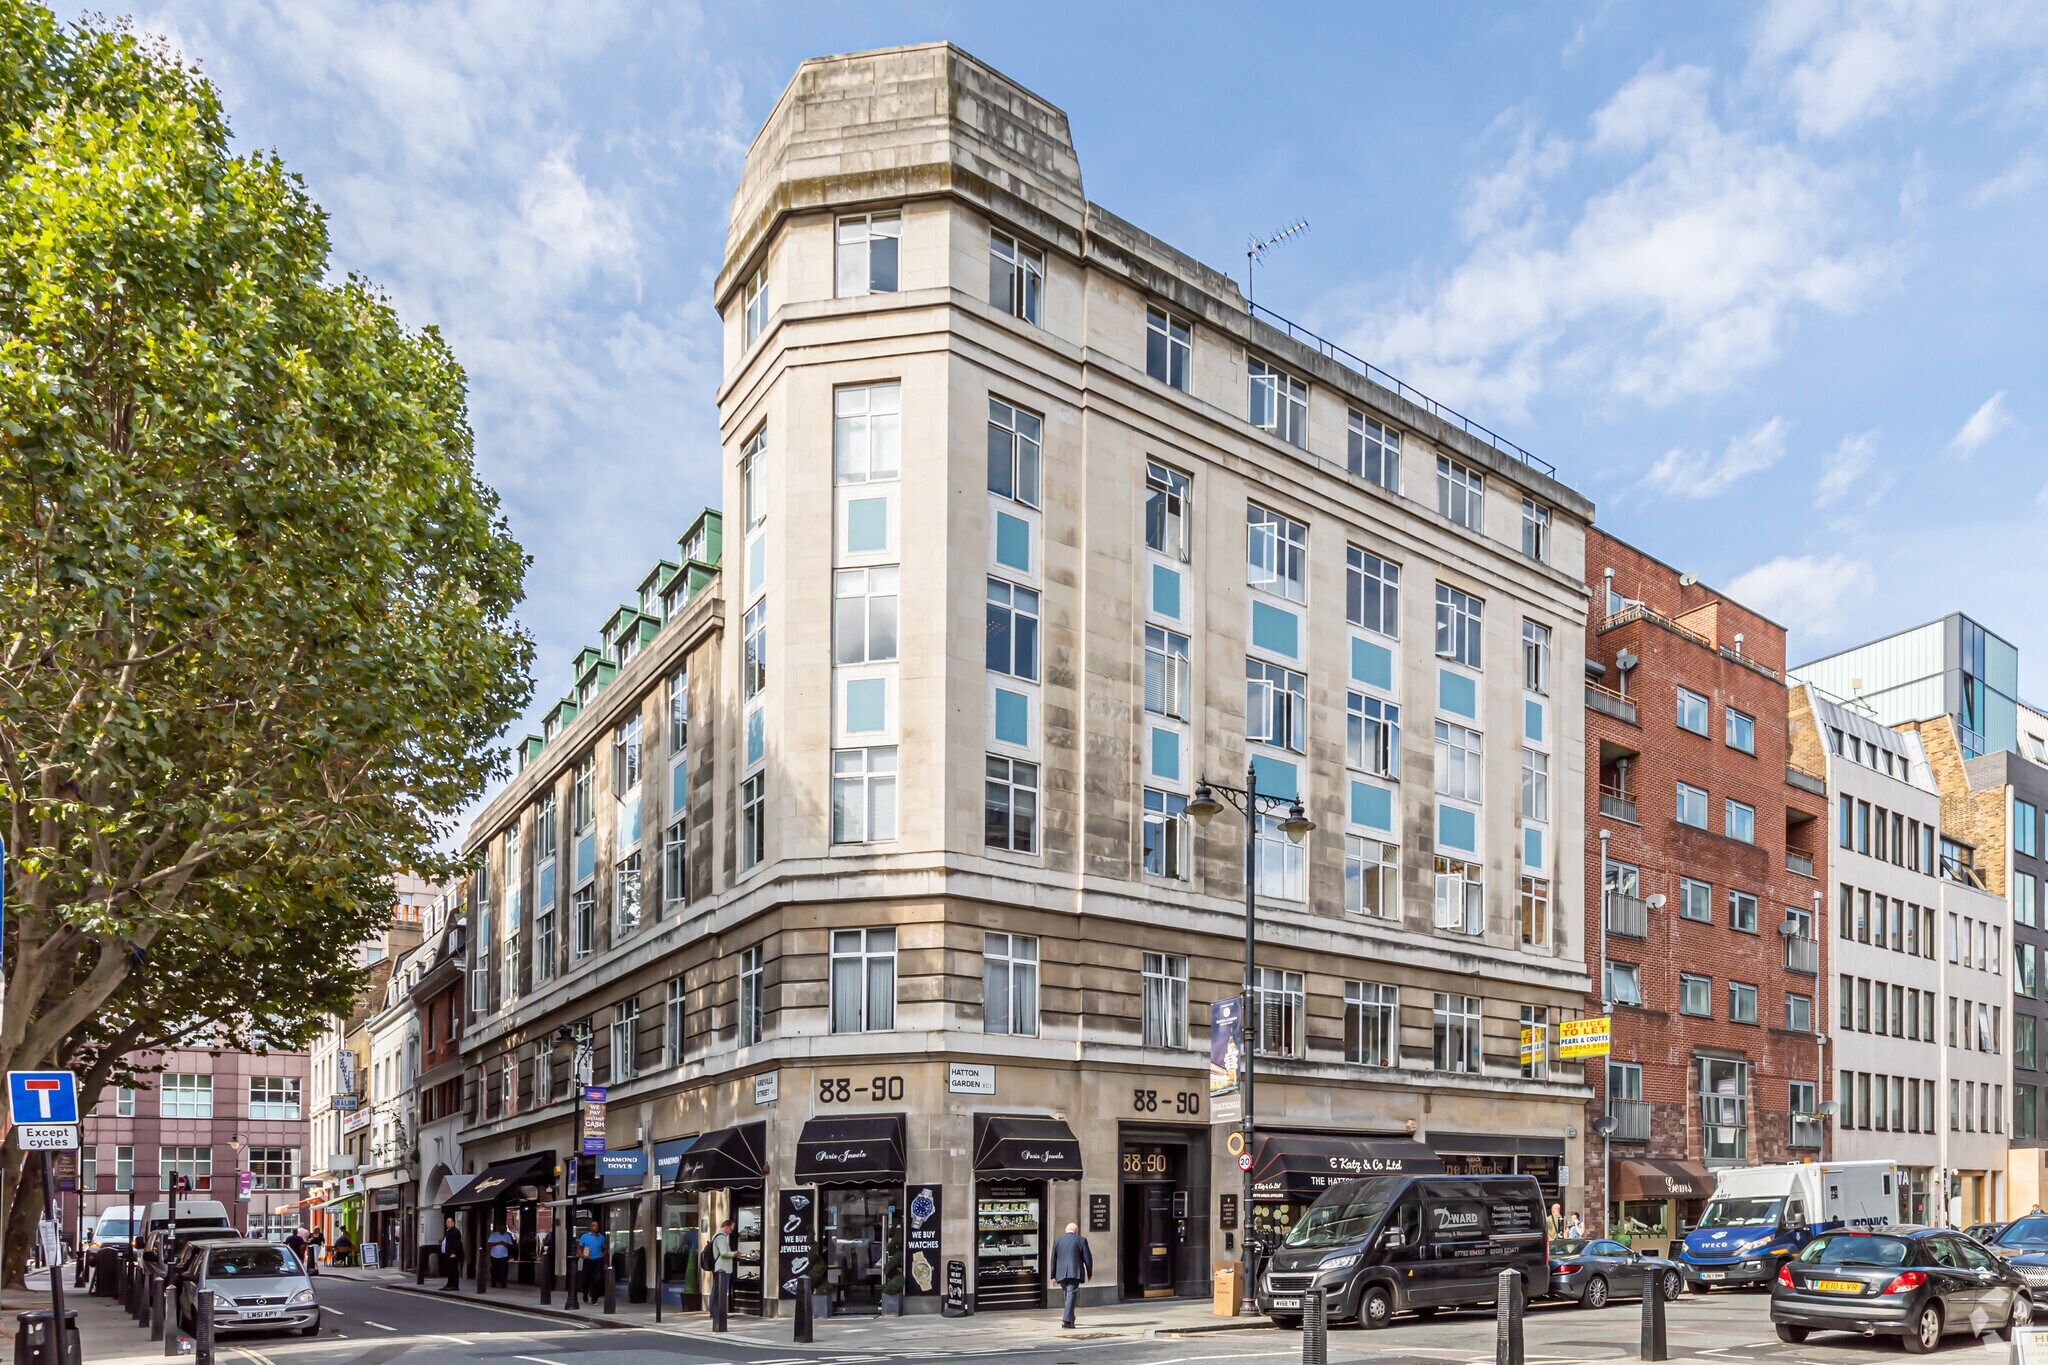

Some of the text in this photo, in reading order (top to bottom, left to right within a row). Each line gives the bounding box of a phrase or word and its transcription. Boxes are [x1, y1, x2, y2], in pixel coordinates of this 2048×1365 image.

[1566, 1020, 1603, 1029] OFFICE
[1562, 1026, 1607, 1037] TO LET
[951, 1069, 979, 1077] HATTON
[757, 1077, 773, 1087] GREVILLE
[952, 1080, 980, 1088] GARDEN
[757, 1089, 770, 1097] STREET
[26, 1128, 69, 1138] Except
[29, 1138, 68, 1148] cycles
[658, 1156, 680, 1166] DIAMOND
[815, 1149, 867, 1163] Paris Jewels
[1021, 1150, 1064, 1163] Paris Jewels
[1240, 1158, 1250, 1166] 20
[1329, 1157, 1402, 1173] E Katz & Co Ltd
[1464, 1160, 1503, 1175] Jewels
[1311, 1176, 1355, 1186] THE HATT
[1665, 1176, 1692, 1193] Gems
[784, 1235, 807, 1243] WE BUY
[912, 1231, 922, 1239] WE
[908, 1241, 939, 1249] WATCHES
